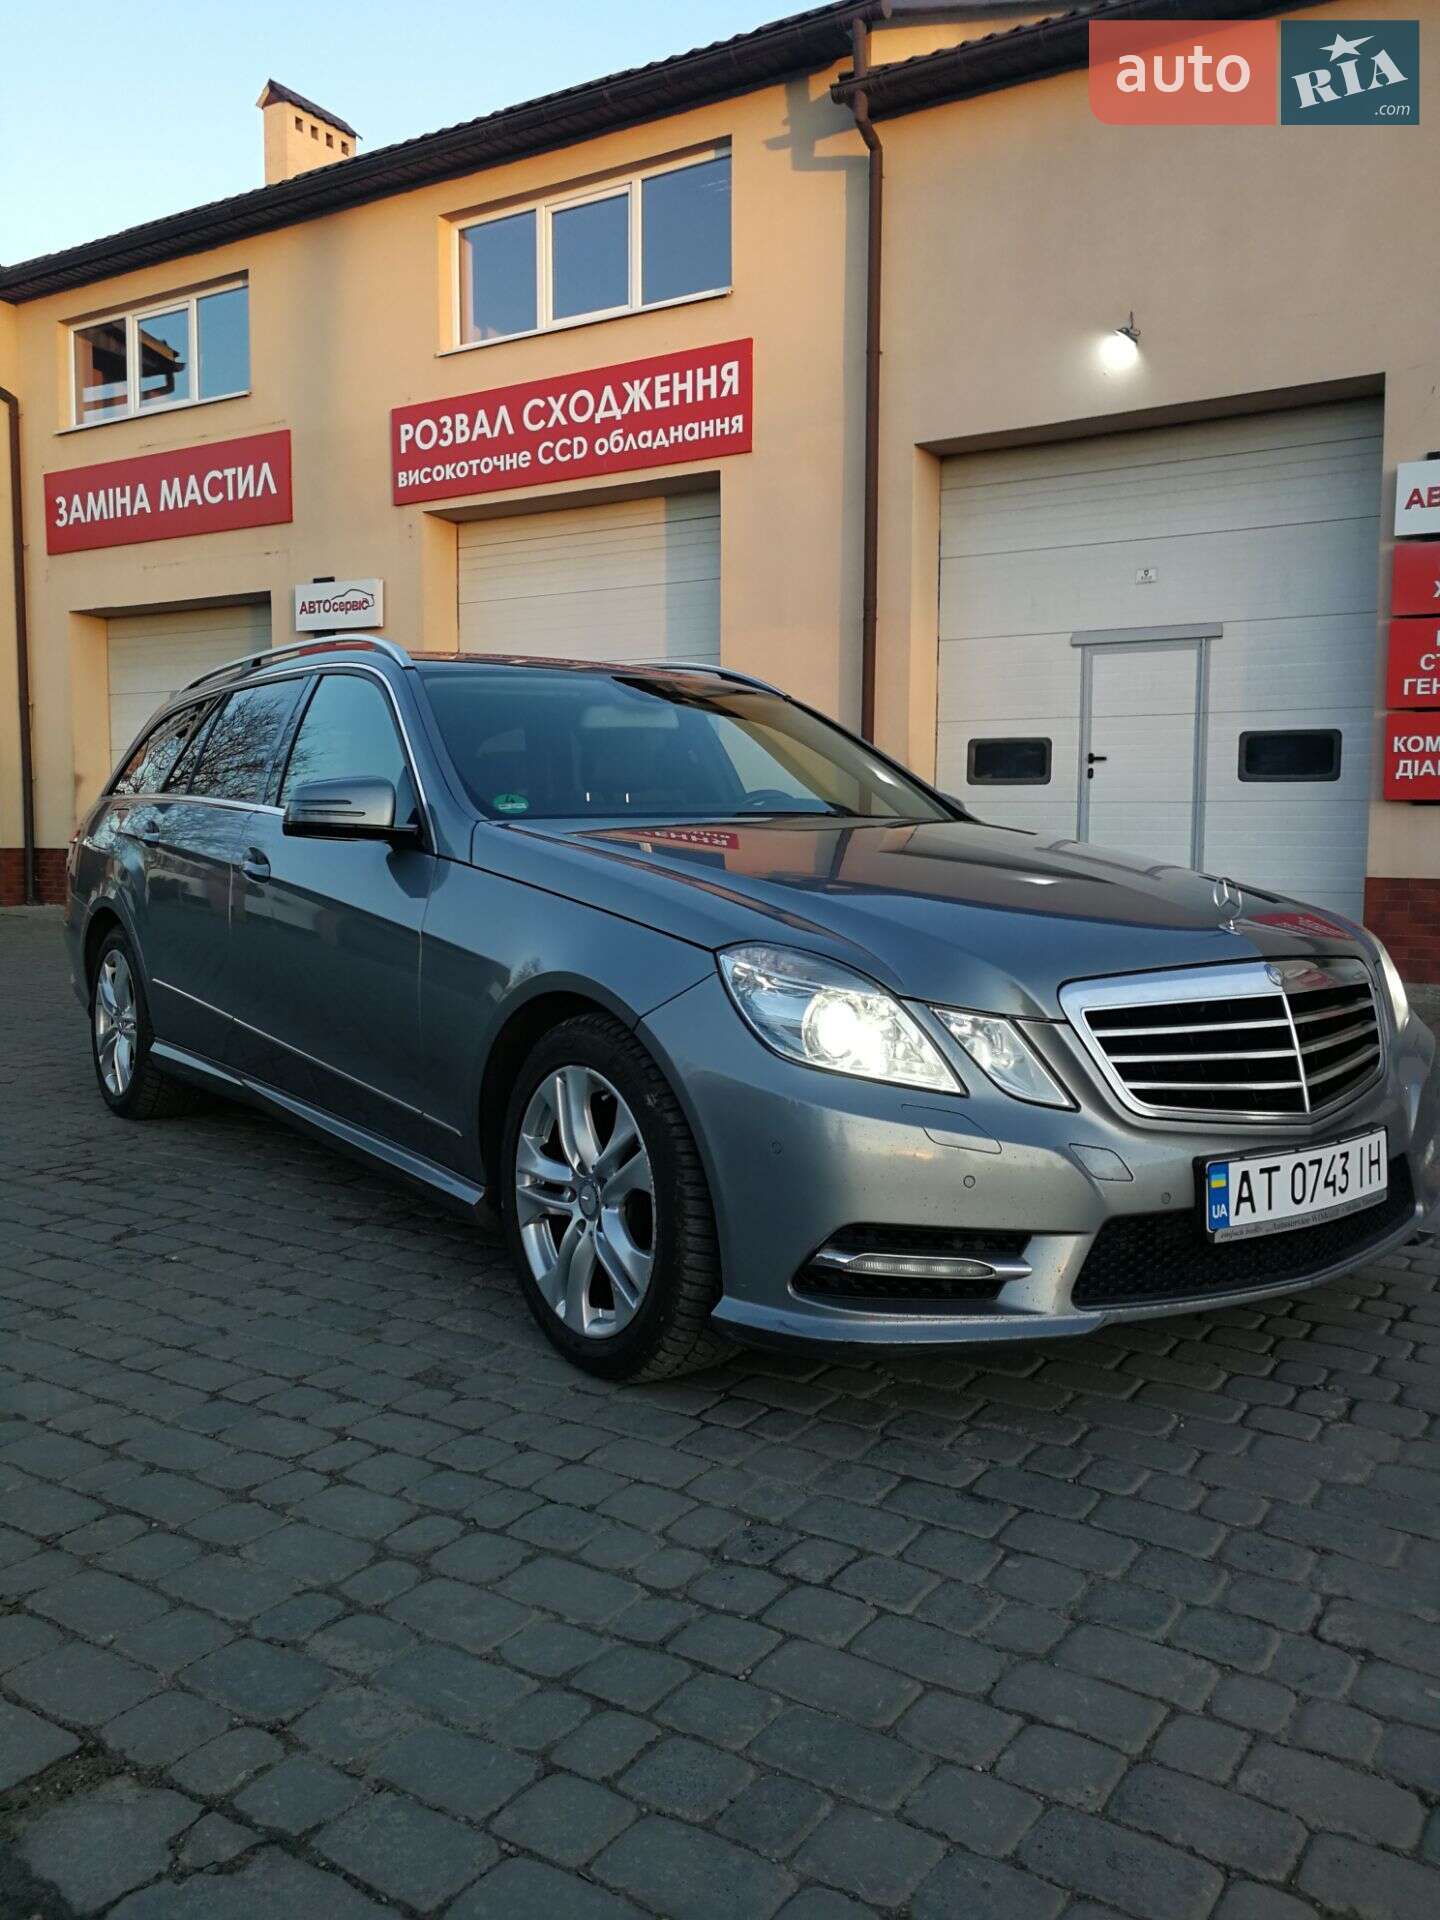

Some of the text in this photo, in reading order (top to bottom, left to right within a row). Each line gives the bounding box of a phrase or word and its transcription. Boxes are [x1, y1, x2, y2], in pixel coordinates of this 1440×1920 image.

[399, 360, 740, 454] РОЗВАЛ СХОДЖЕННЯ
[397, 414, 744, 488] високоточне CCD обладнання
[55, 462, 278, 528] ЗАМІНА МАСТИЛ
[1212, 1204, 1228, 1219] UA
[1234, 1165, 1281, 1216] AT
[1290, 1151, 1349, 1205] 0743
[1359, 1140, 1381, 1188] IH
